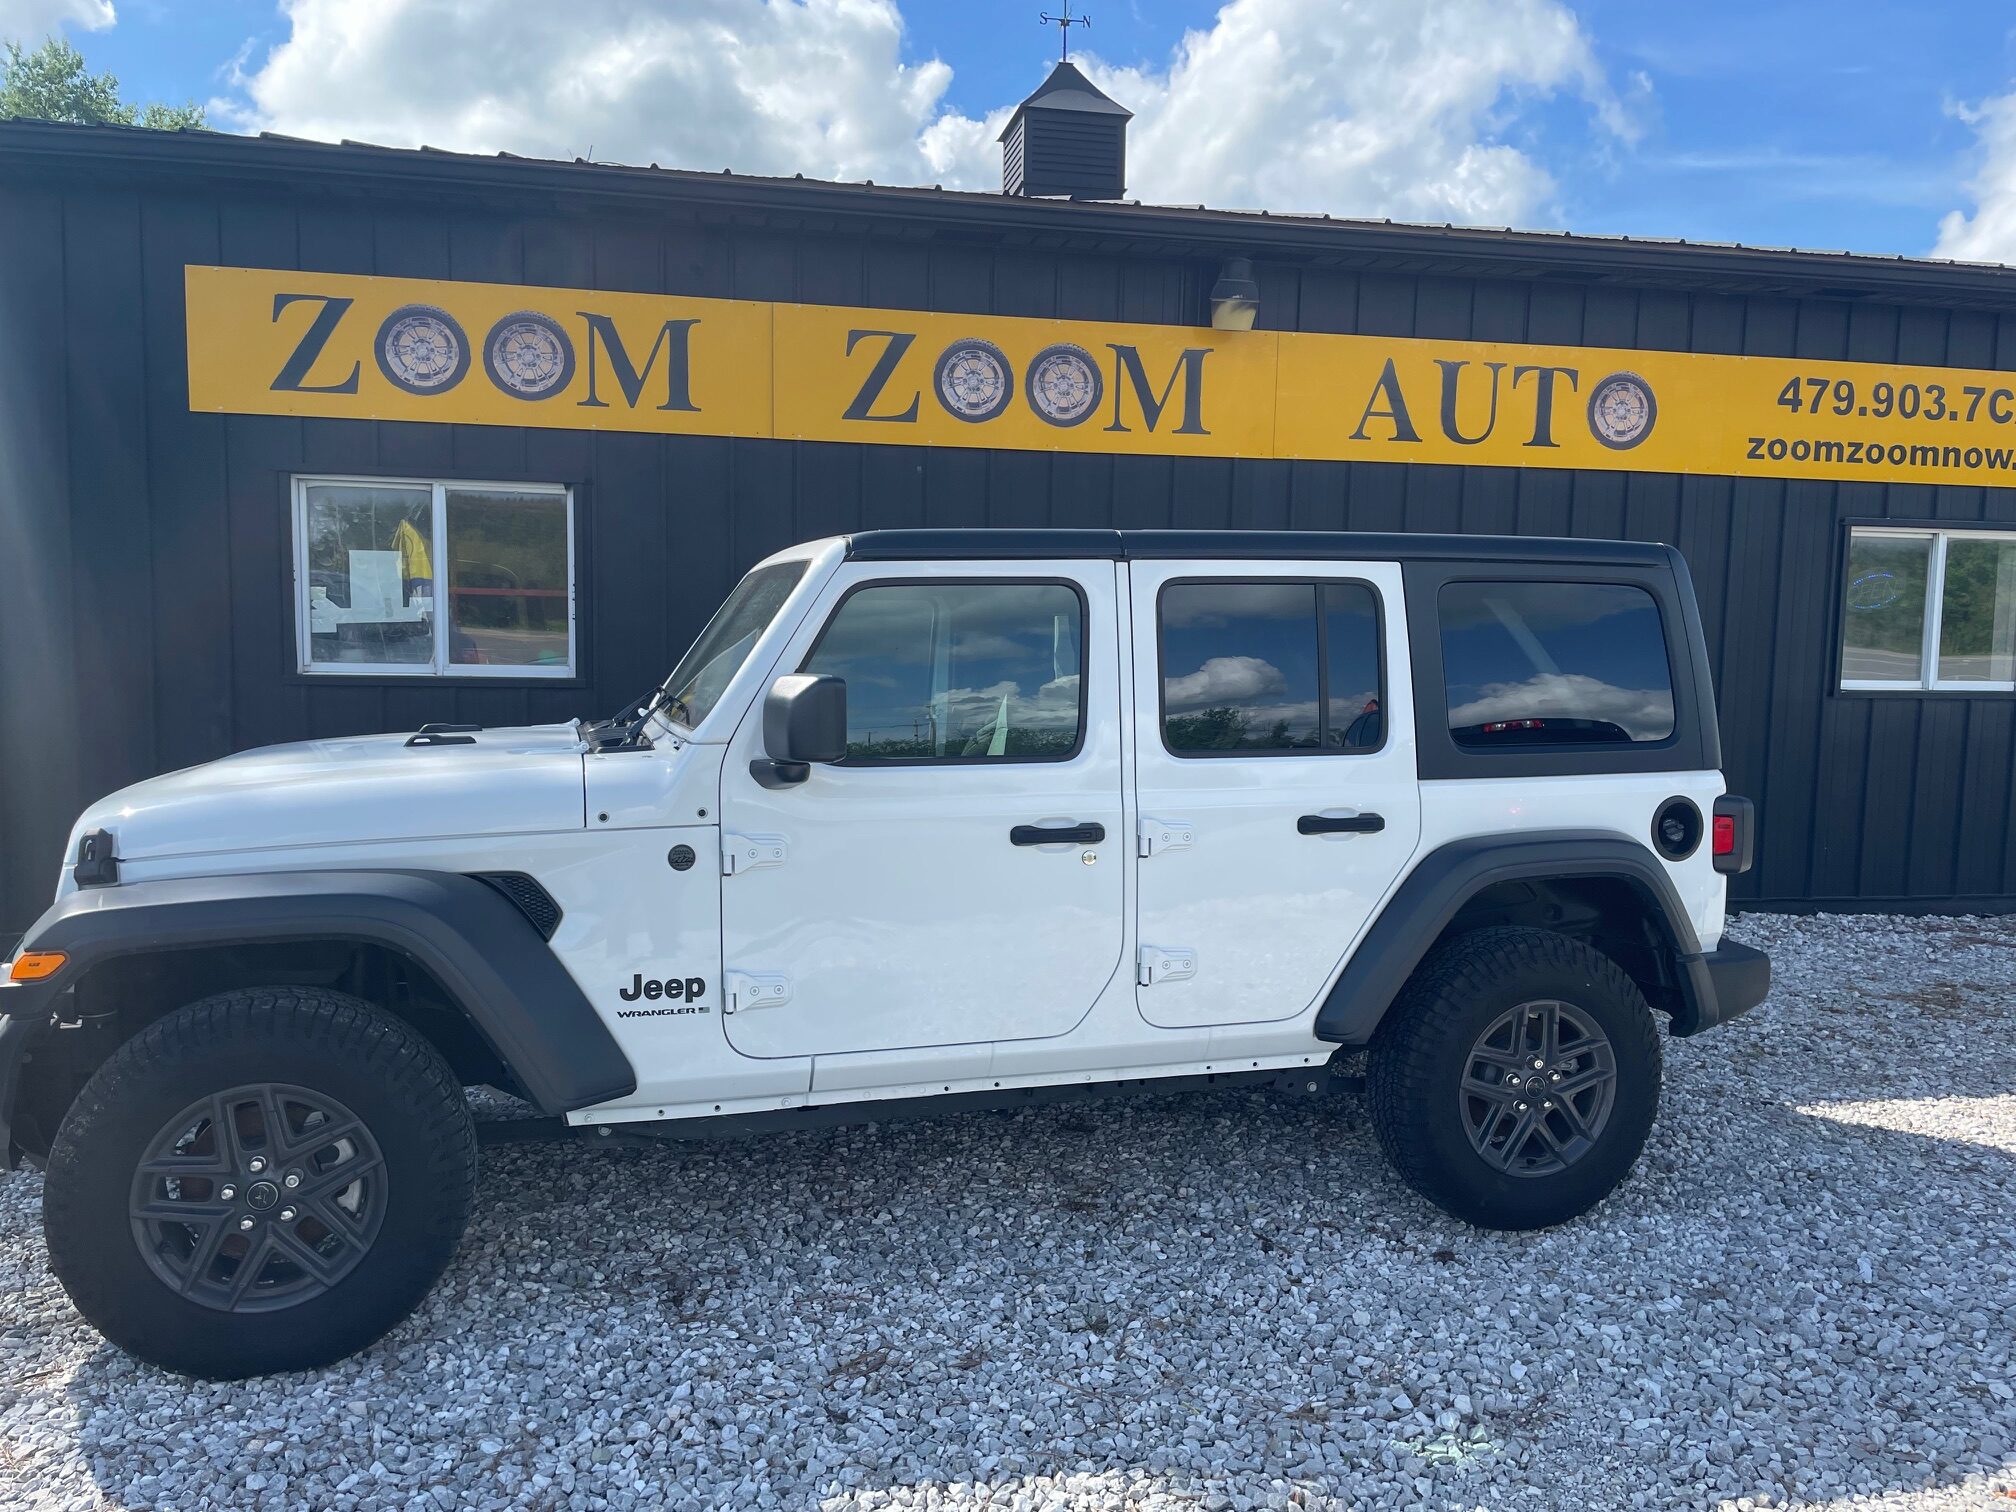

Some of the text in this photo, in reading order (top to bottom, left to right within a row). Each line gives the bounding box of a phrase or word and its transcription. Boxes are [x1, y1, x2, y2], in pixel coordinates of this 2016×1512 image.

[269, 293, 1657, 451] ZOOM ZOOM AUTO
[1777, 376, 2016, 425] 479.903.7C
[619, 974, 706, 1004] Jeep
[617, 1007, 696, 1018] WRANGLER
